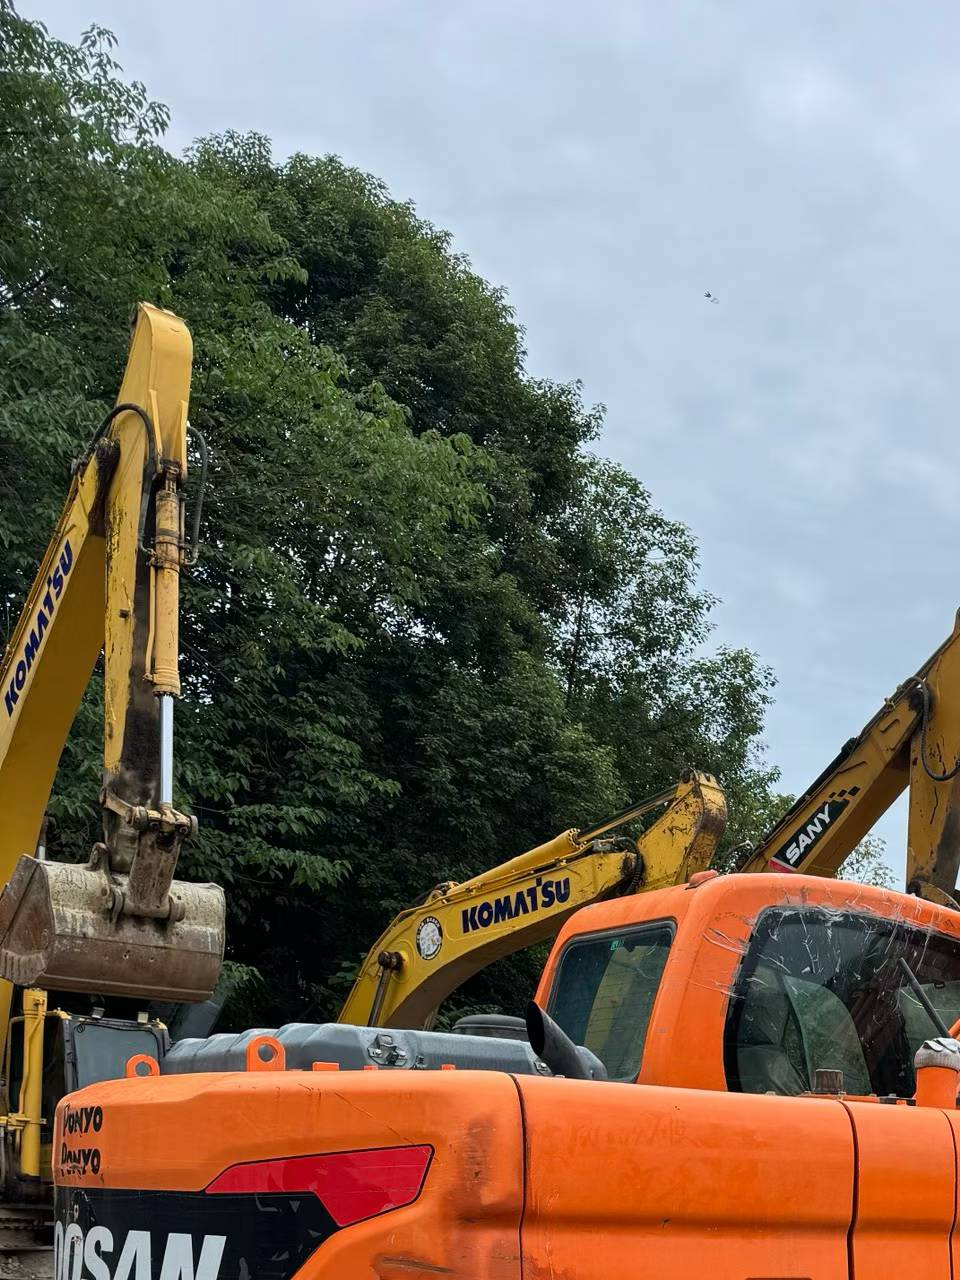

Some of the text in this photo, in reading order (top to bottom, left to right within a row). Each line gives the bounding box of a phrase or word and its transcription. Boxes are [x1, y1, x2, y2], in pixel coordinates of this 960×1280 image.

[4, 540, 74, 718] KOMATSU
[785, 803, 831, 865] SANY
[461, 876, 571, 934] KOMATSU
